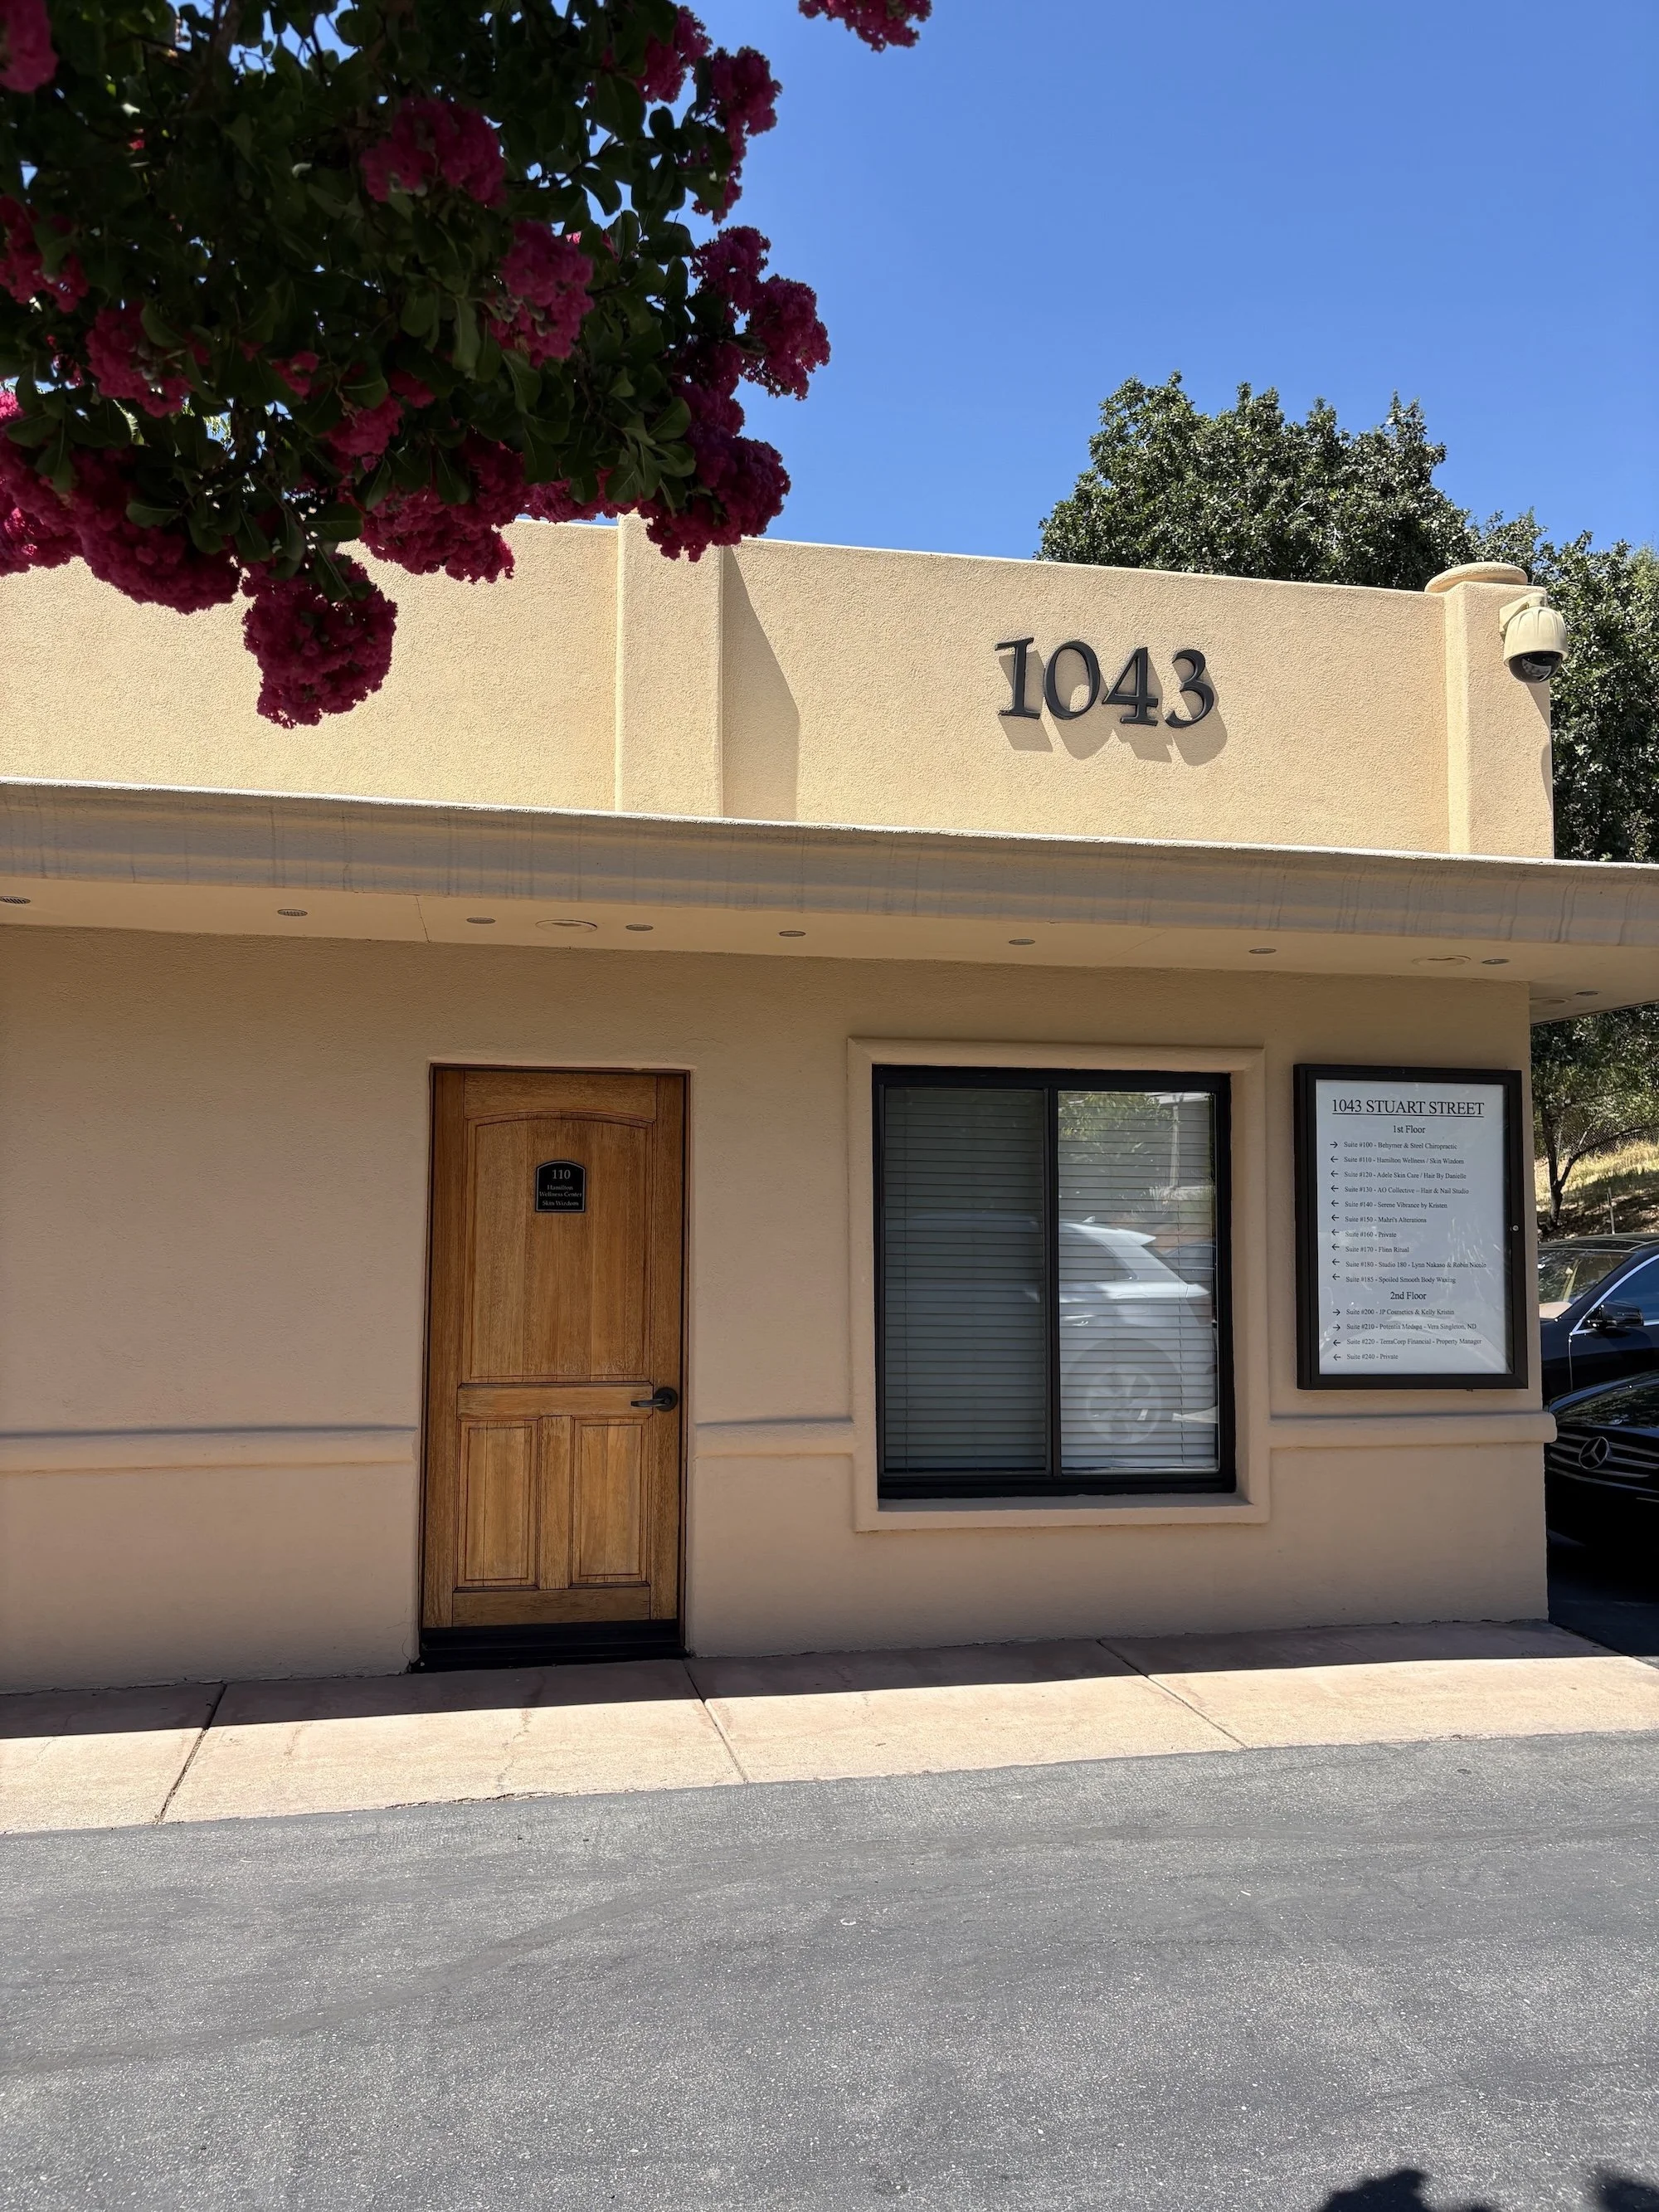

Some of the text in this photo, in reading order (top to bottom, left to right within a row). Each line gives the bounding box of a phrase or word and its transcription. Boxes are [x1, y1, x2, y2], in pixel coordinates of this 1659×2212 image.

[995, 637, 1214, 728] 1043
[1332, 1099, 1485, 1115] 1043 STUART STREET
[1393, 1125, 1426, 1134] 1st Floor
[552, 1169, 571, 1179] 110
[1390, 1291, 1427, 1300] 2nd Floor
